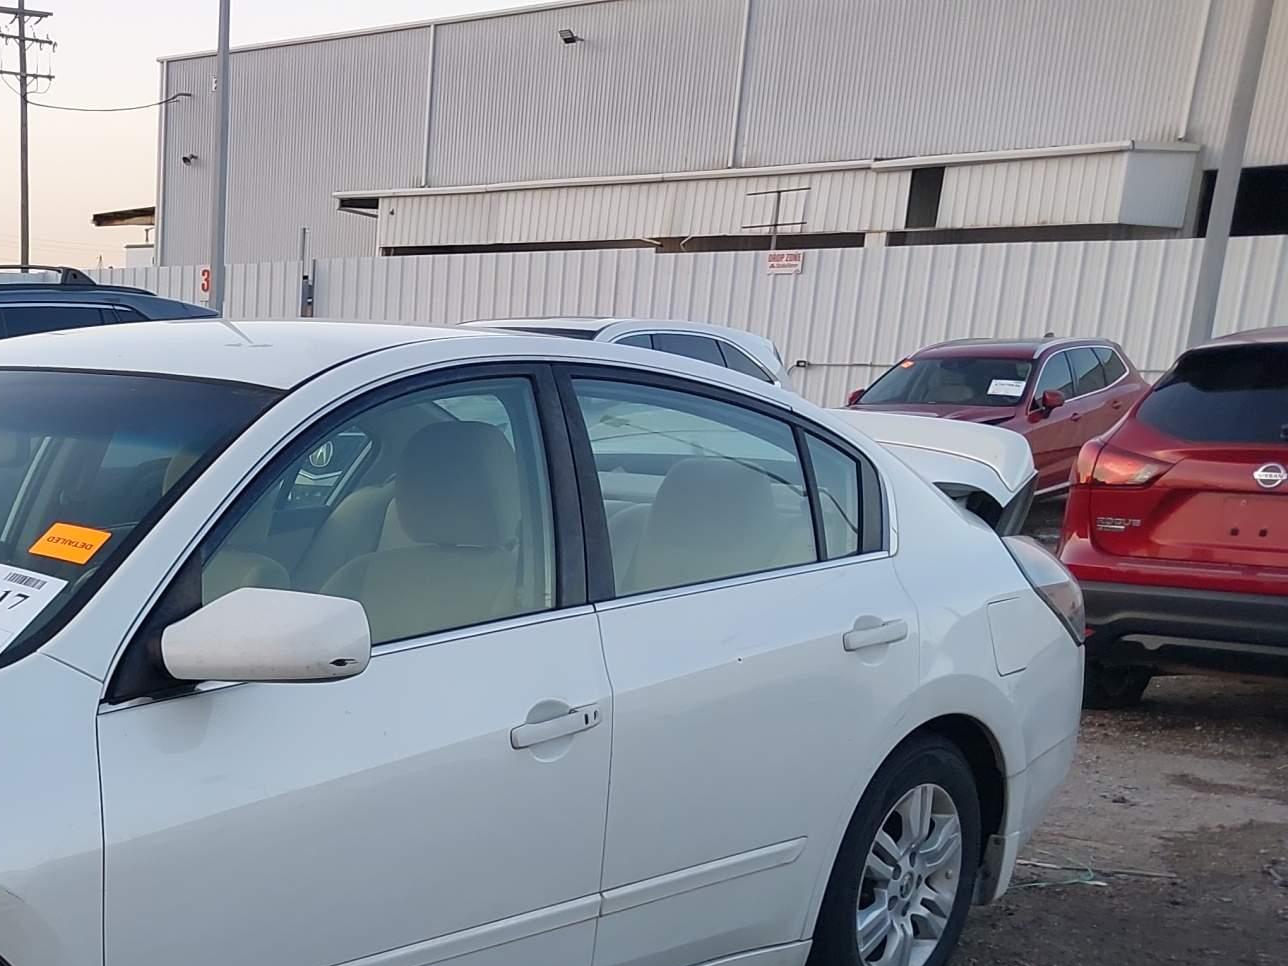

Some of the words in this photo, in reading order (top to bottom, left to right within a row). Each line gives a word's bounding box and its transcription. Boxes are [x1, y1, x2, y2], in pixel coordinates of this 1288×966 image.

[201, 269, 210, 292] 3
[1096, 516, 1141, 527] ROGUE
[47, 536, 94, 551] DETAILED
